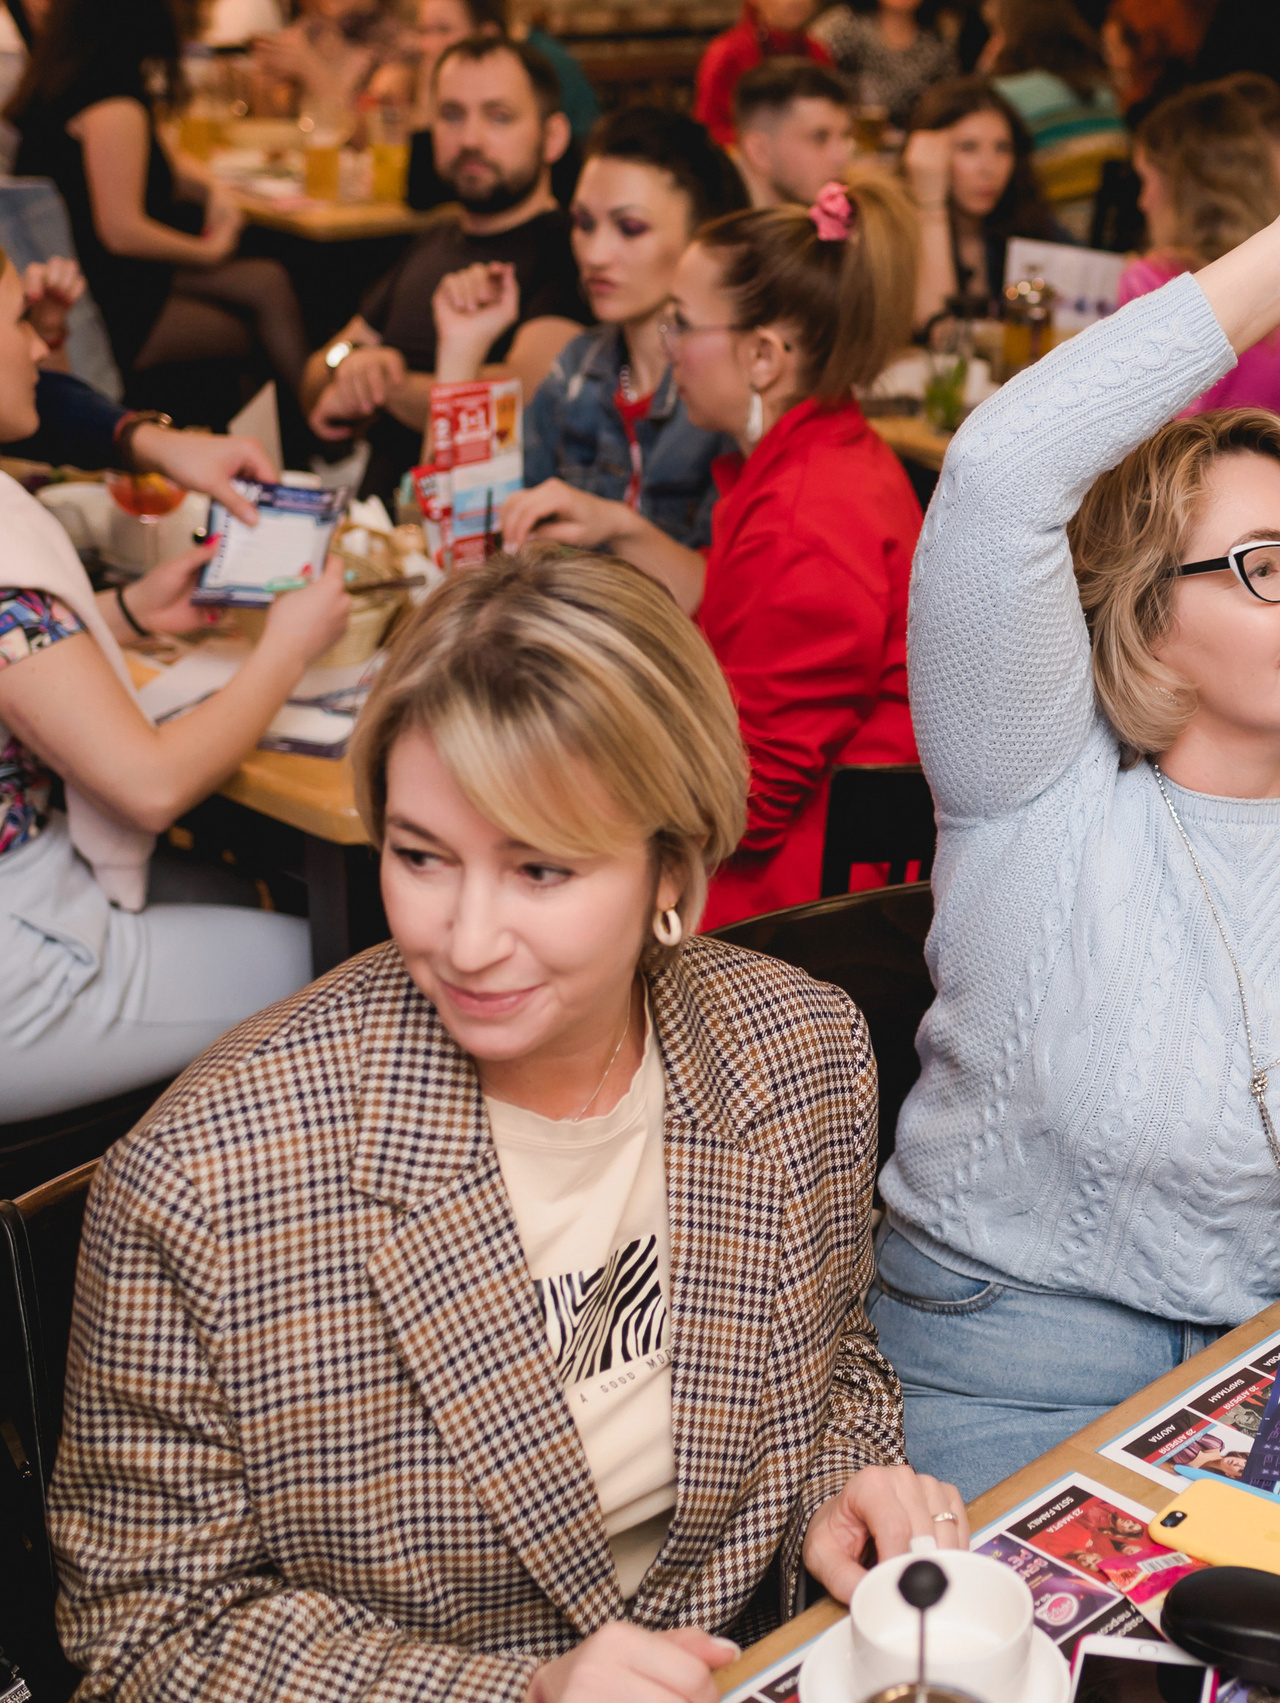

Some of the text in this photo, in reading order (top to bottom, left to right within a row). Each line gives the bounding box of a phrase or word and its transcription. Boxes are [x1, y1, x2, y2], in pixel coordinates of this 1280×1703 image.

[580, 1393, 588, 1403] A
[600, 1371, 636, 1393] GOOD
[1208, 1378, 1246, 1403] БИРТМАН
[1223, 1385, 1260, 1410] 20 АПРЕЛЯ
[1148, 1423, 1176, 1443] АКУЛА
[1158, 1428, 1197, 1455] 29 АПРЕЛЯ
[1026, 1496, 1075, 1530] 5STA FAMILY
[1046, 1507, 1084, 1533] 23 МАРТА
